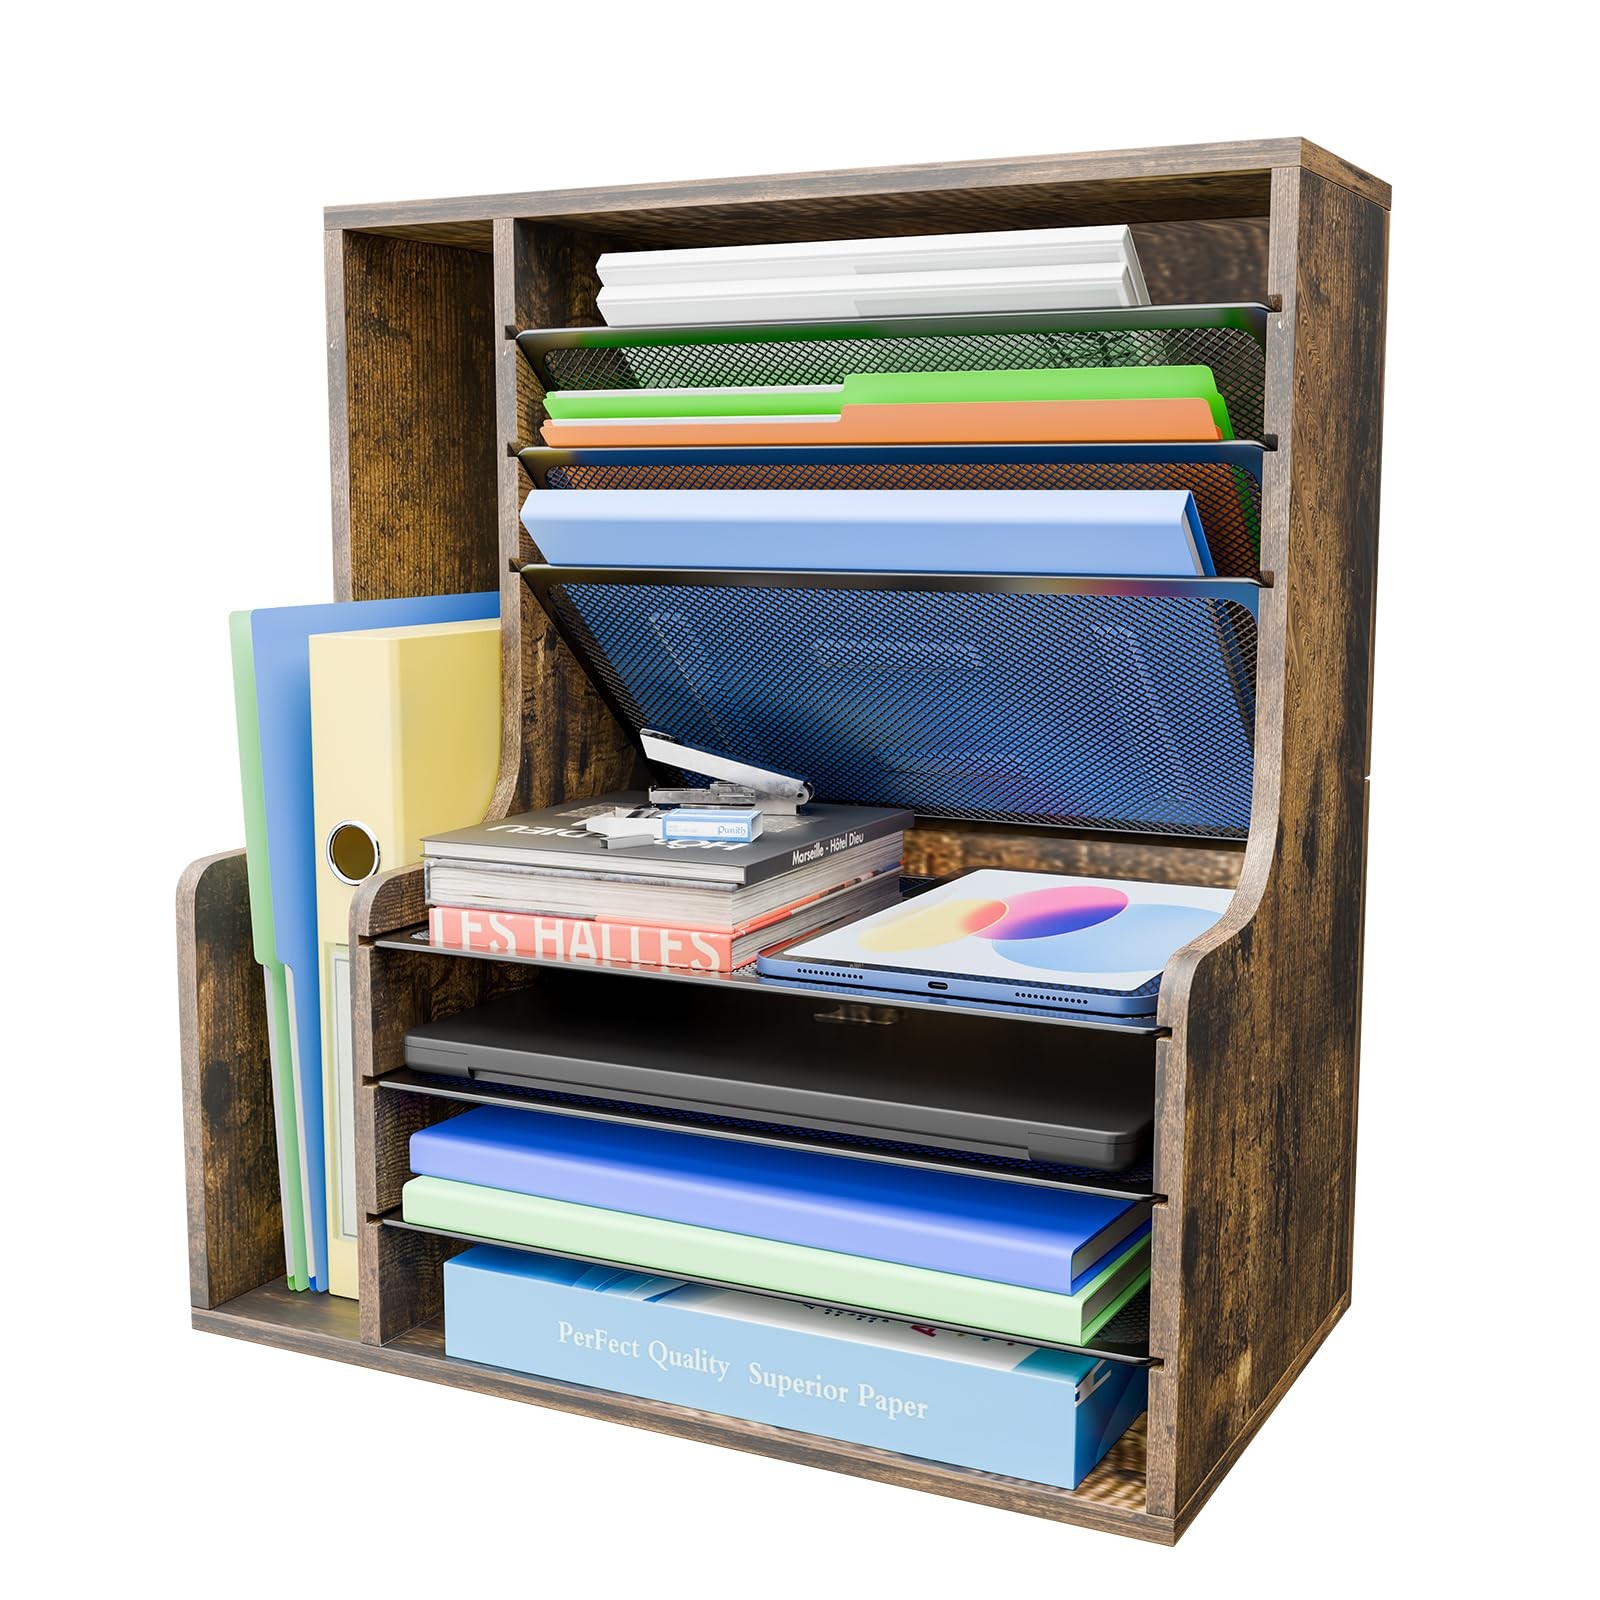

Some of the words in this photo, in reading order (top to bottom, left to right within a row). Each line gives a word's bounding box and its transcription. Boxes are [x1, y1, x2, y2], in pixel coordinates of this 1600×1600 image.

[792, 842, 824, 866] Marseille
[830, 832, 848, 853] Hôtel
[849, 831, 864, 847] Dieu
[433, 908, 516, 953] LES
[534, 917, 720, 972] HALLES
[558, 1320, 641, 1359] PerFect
[648, 1339, 731, 1383] Quality
[749, 1361, 849, 1403] Superior
[857, 1383, 928, 1421] Paper
